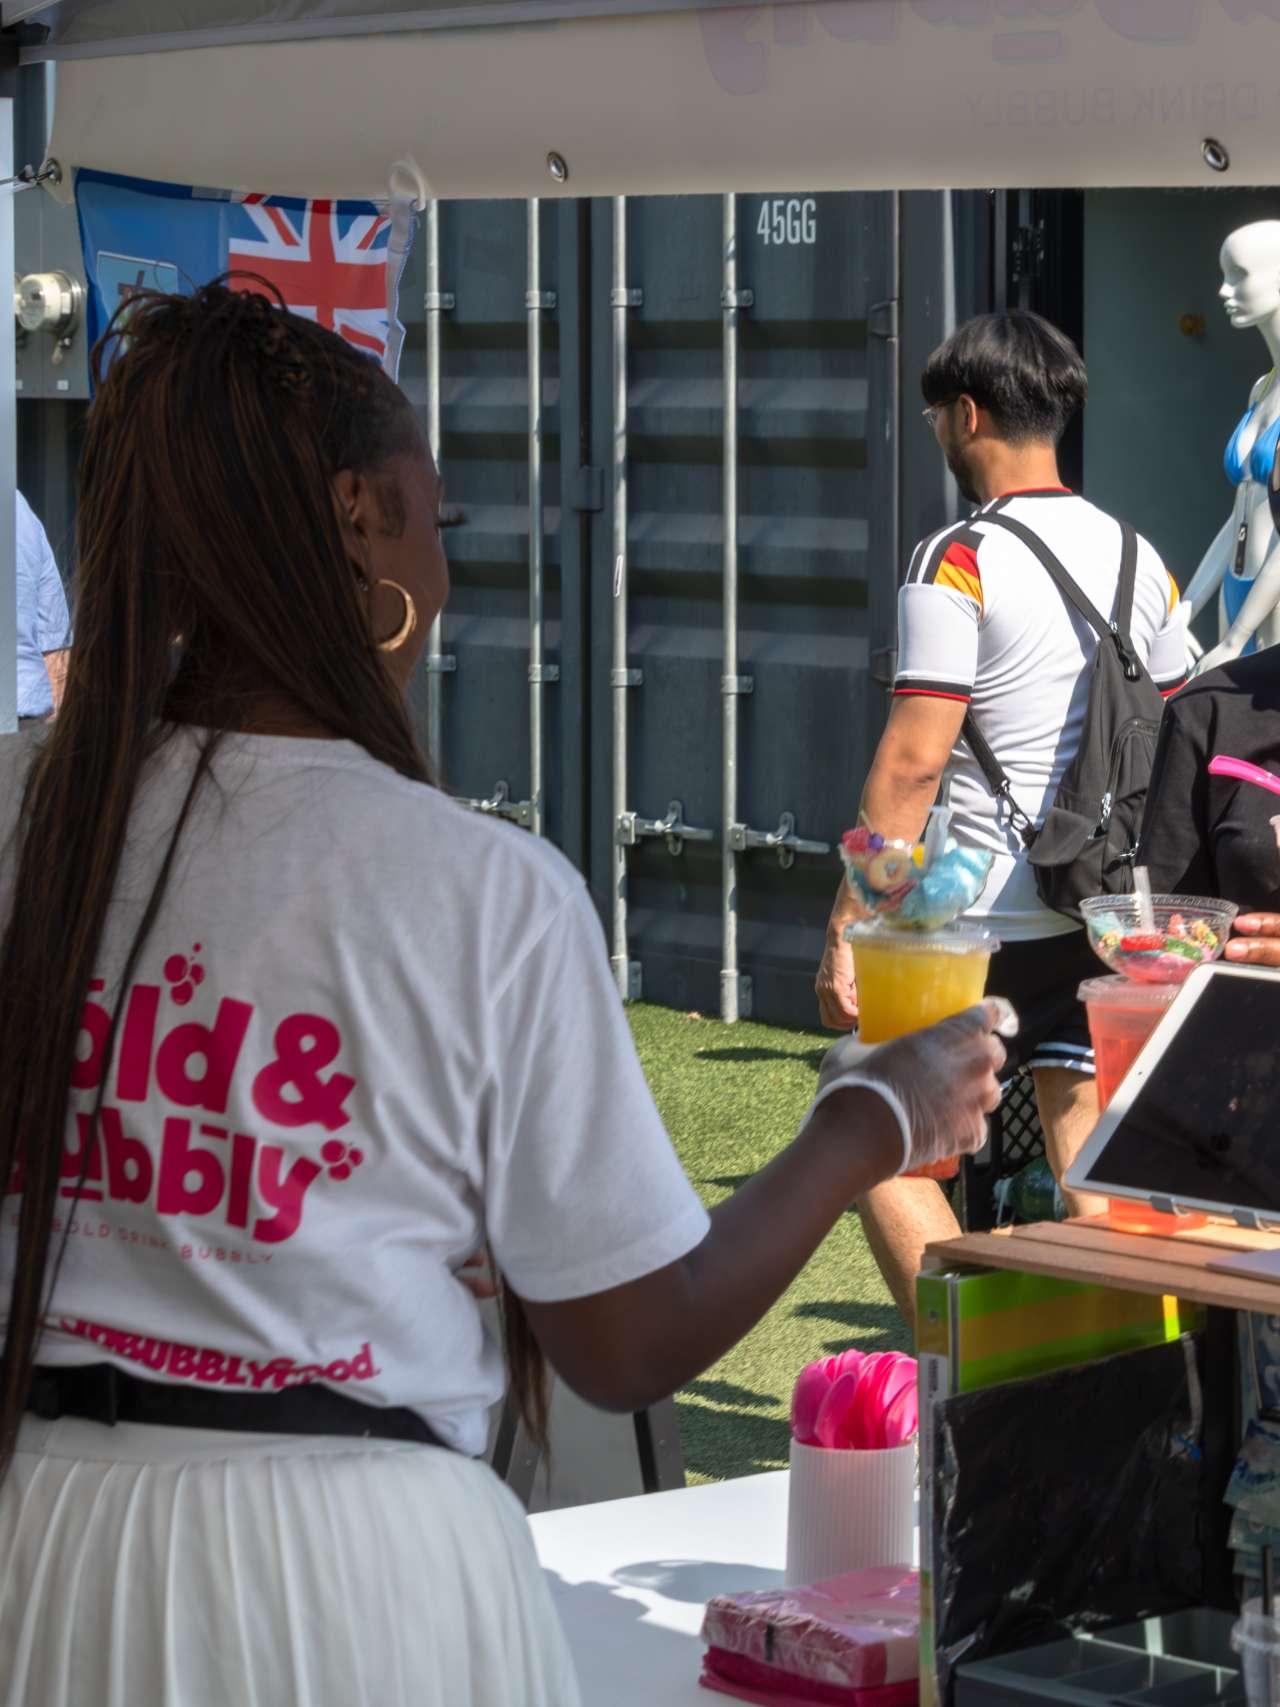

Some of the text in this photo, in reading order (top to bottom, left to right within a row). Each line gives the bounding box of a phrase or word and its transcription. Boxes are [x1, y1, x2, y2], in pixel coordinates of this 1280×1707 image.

[756, 198, 816, 245] 45GG
[70, 980, 357, 1131] old &
[60, 1106, 322, 1243] ubbly
